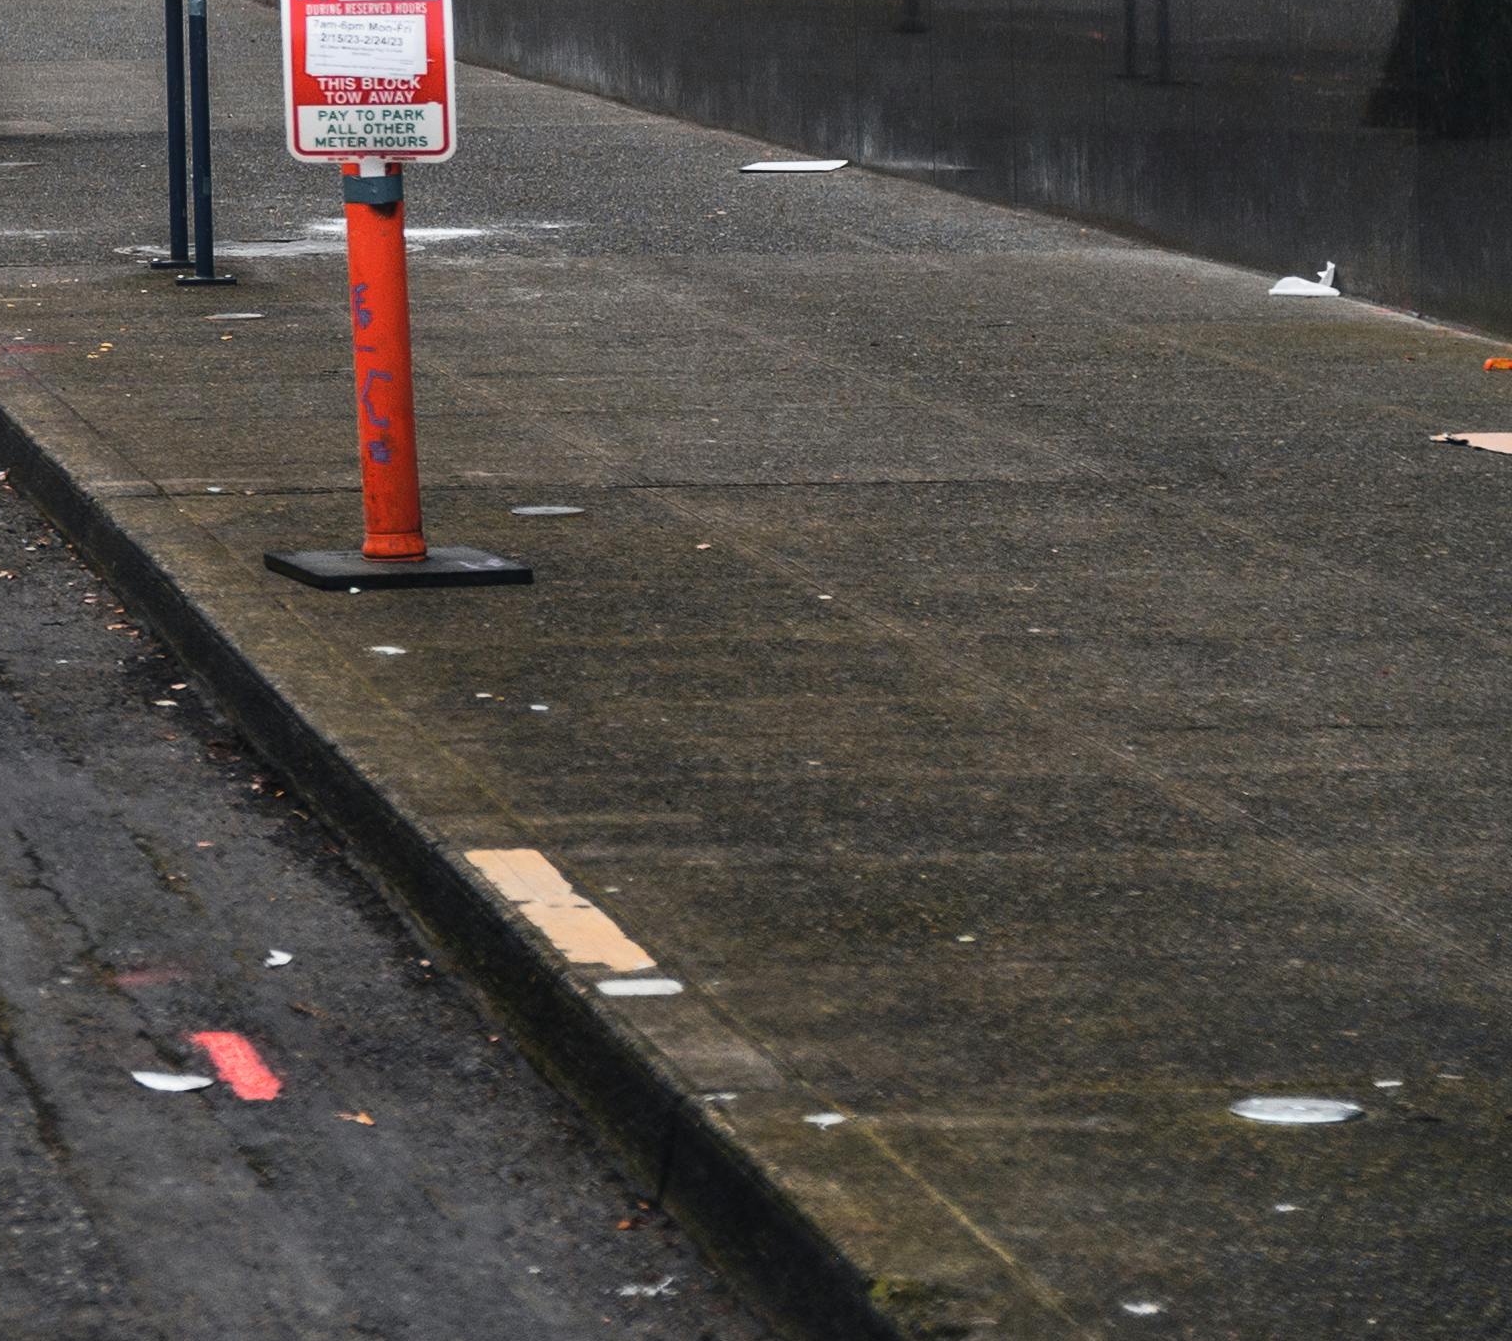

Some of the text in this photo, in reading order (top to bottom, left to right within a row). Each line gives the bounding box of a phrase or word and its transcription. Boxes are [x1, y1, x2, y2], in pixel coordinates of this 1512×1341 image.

[305, 2, 428, 15] DURING RESERVED HOURS
[369, 22, 413, 33] Mon-Fri
[320, 32, 404, 46] 2/15/23-2/24/23
[317, 77, 422, 91] THIS BLOCK
[324, 91, 415, 104] TOW AWAY
[318, 109, 425, 121] PAY TO PARK
[327, 123, 415, 135] ALL OTHER
[315, 136, 428, 147] METER HOURS
